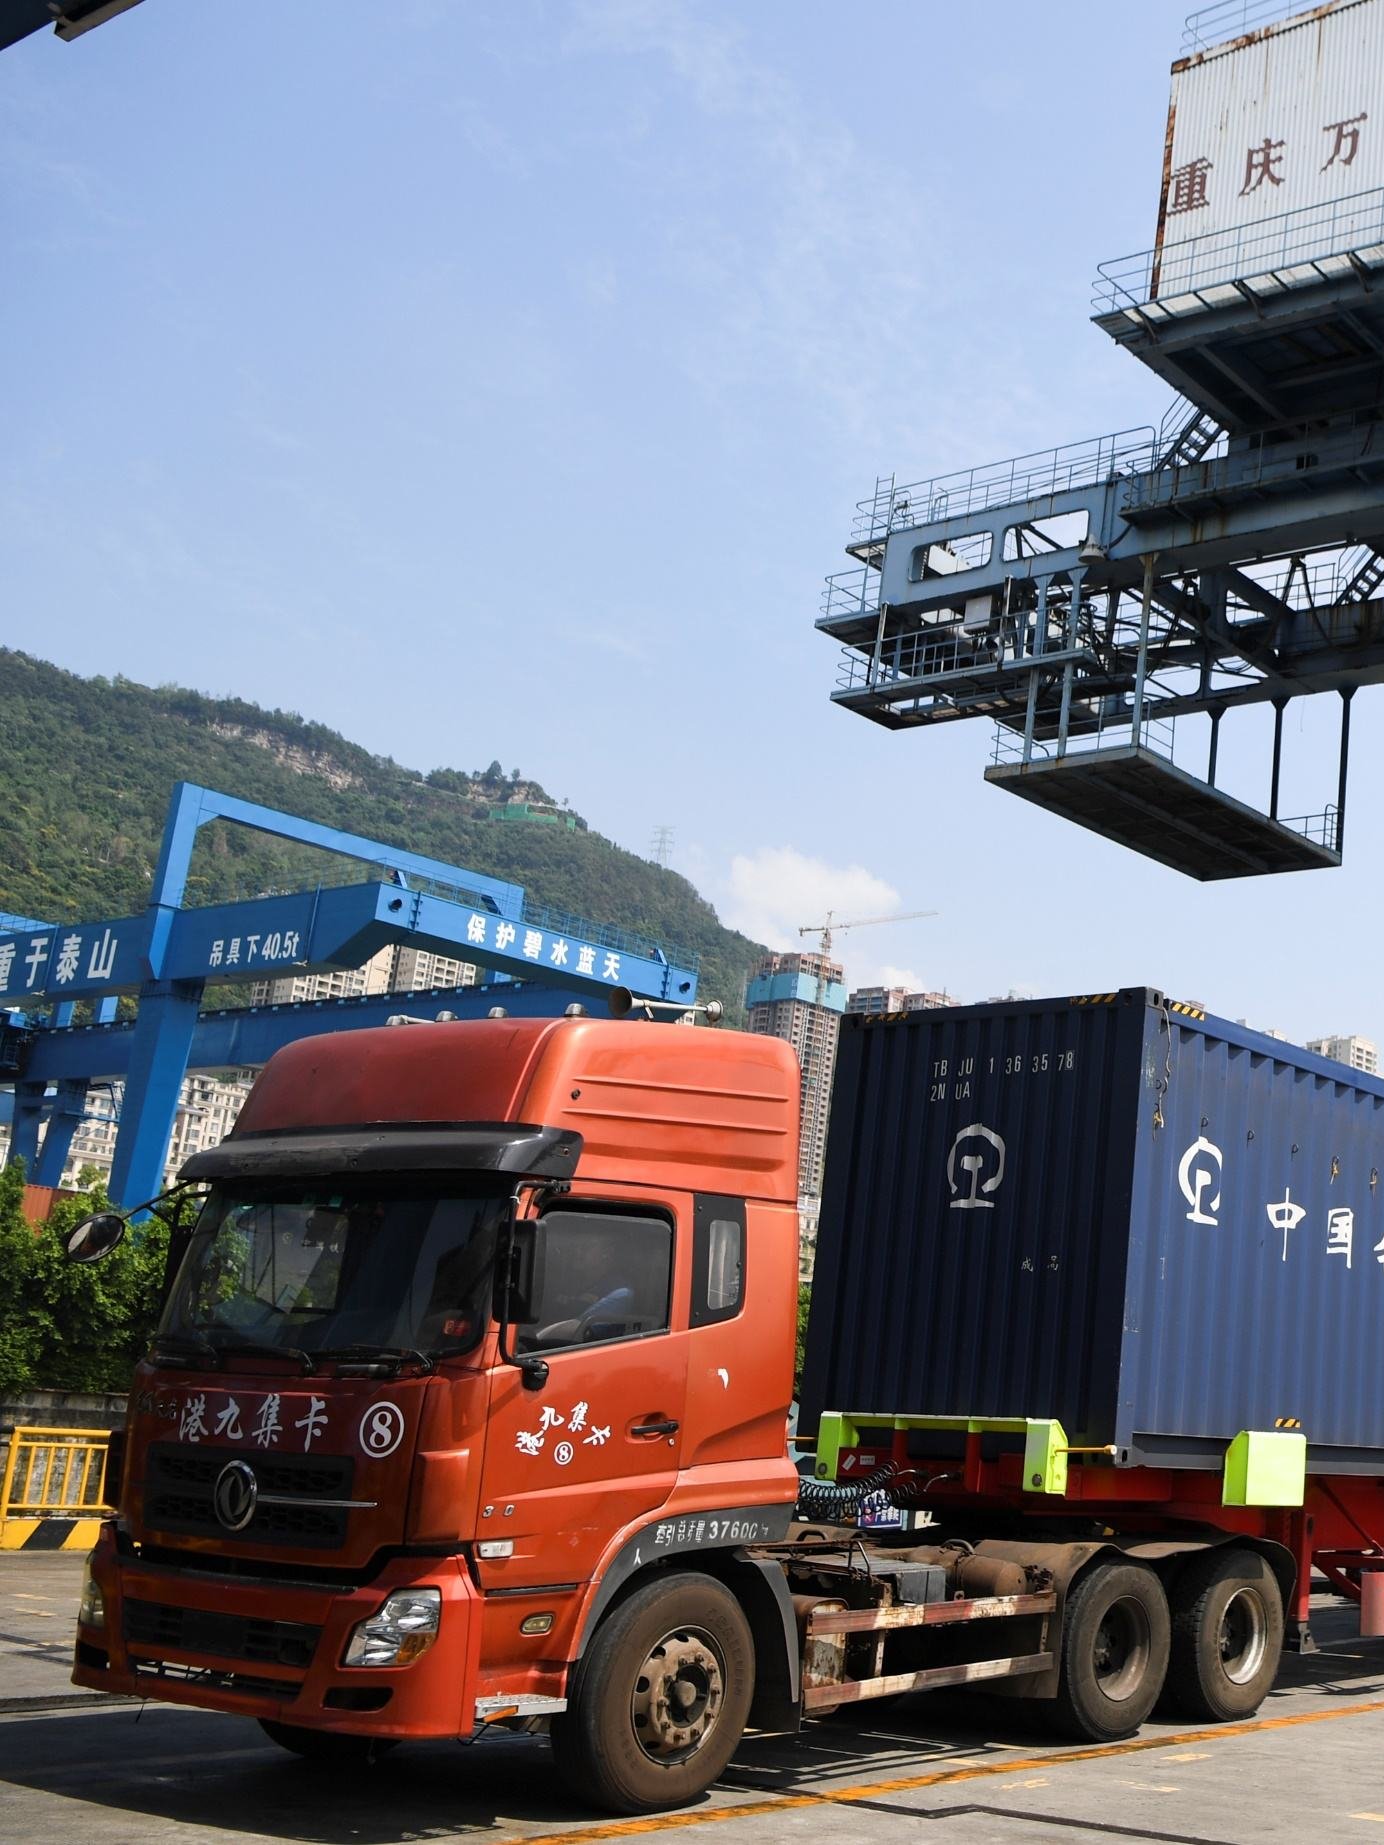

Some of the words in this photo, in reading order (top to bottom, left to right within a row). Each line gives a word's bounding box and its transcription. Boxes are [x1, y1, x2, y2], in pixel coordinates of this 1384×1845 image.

[209, 930, 300, 968] 吊具下40.5t
[467, 913, 621, 981] 保护碧水蓝天
[178, 1394, 329, 1452] 港九集卡
